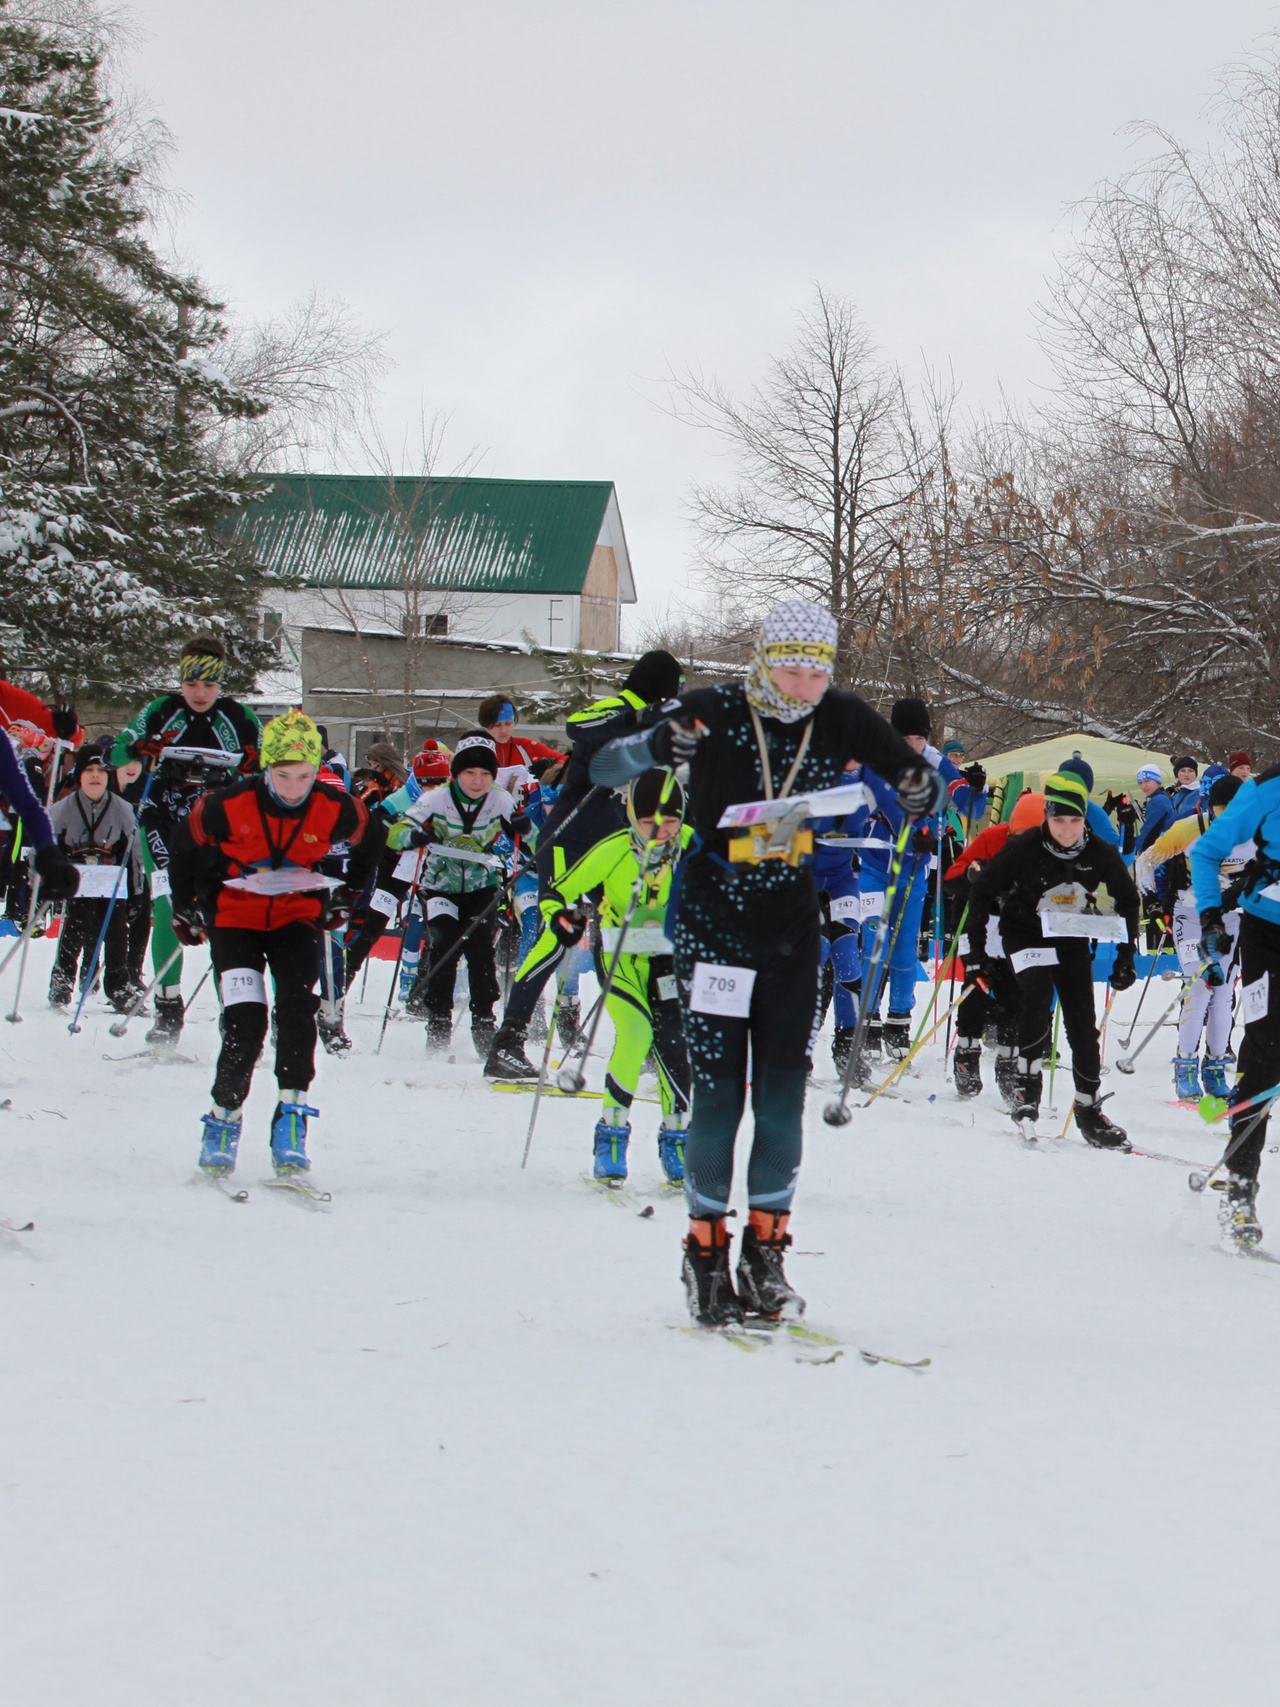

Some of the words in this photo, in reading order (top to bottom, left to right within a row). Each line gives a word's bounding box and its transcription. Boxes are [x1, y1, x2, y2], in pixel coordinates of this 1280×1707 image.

[156, 876, 169, 884] 73
[838, 901, 853, 909] 747
[862, 898, 876, 906] 757
[232, 976, 253, 987] 719
[708, 976, 737, 993] 709
